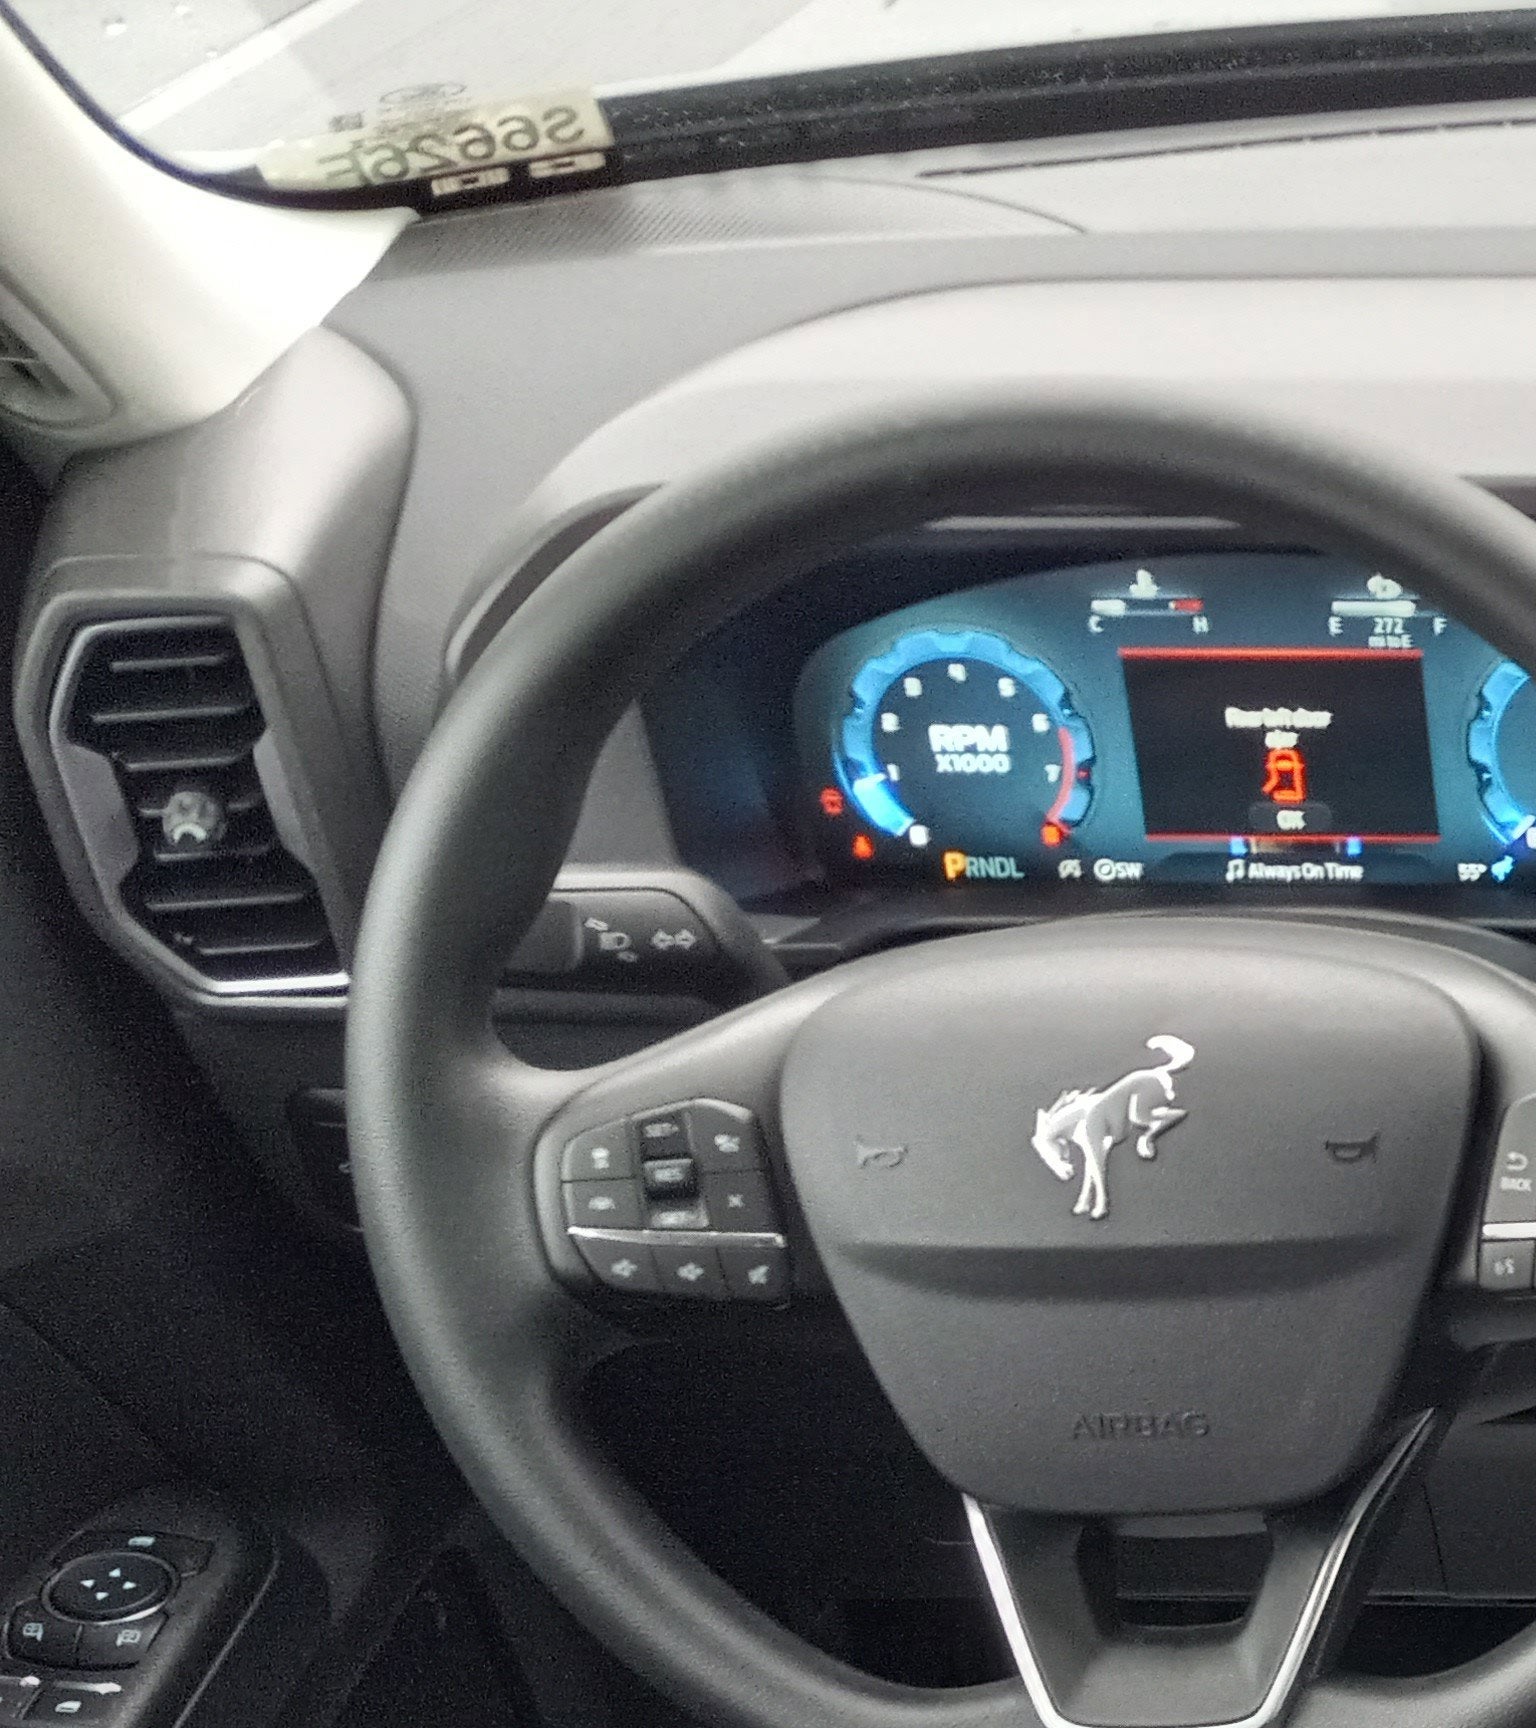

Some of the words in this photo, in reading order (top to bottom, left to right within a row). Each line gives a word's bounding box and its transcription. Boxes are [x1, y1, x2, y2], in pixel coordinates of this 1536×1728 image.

[1328, 616, 1343, 636] E
[1374, 617, 1404, 634] 272
[1433, 617, 1447, 636] F
[929, 724, 1010, 753] RPM
[1249, 863, 1300, 882] Always
[1302, 863, 1324, 879] On
[1325, 863, 1363, 879] Time
[1072, 1411, 1210, 1441] AIRBAG
